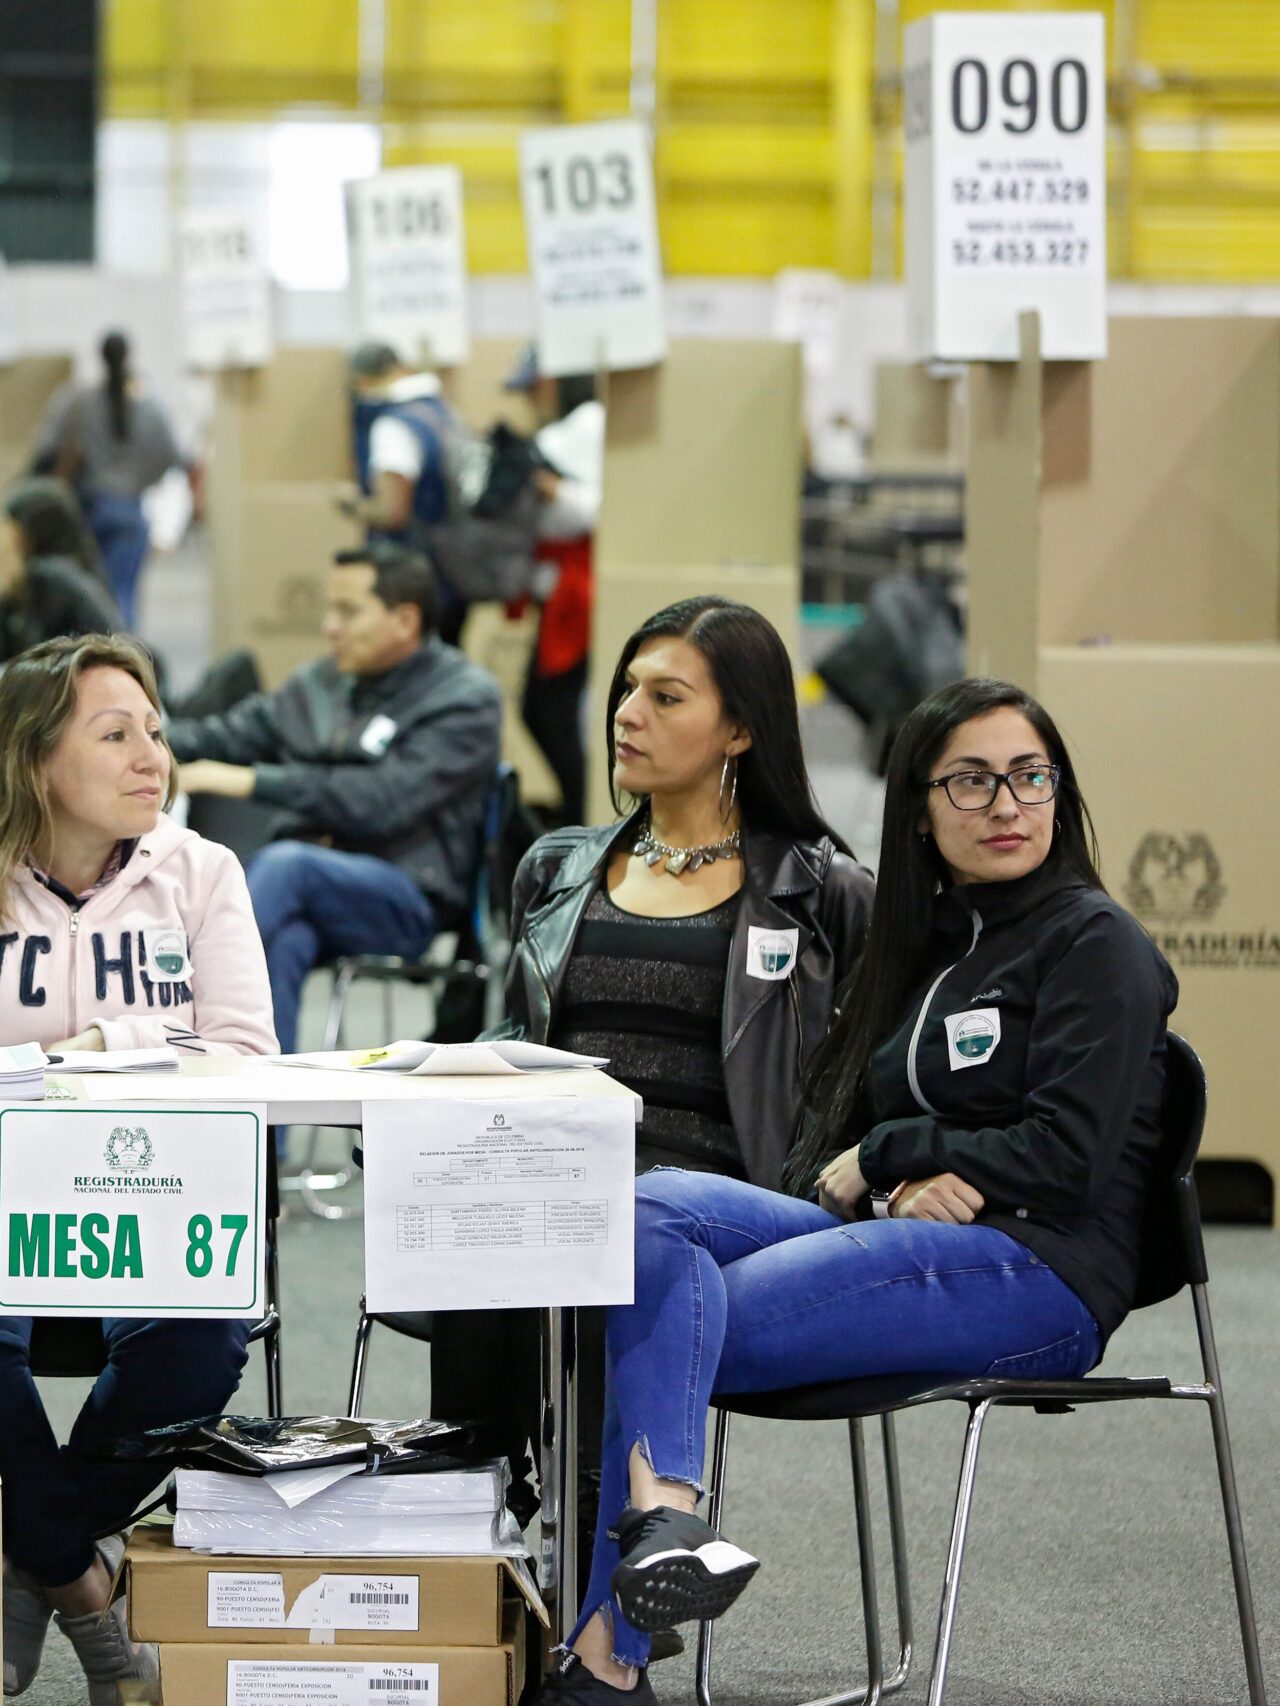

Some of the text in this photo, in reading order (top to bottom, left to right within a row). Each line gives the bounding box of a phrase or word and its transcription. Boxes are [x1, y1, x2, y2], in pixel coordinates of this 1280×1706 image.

[951, 59, 1088, 135] 090
[535, 153, 635, 213] 103
[74, 1175, 183, 1187] REGISTRADURÍA
[9, 1213, 248, 1279] MESA 87
